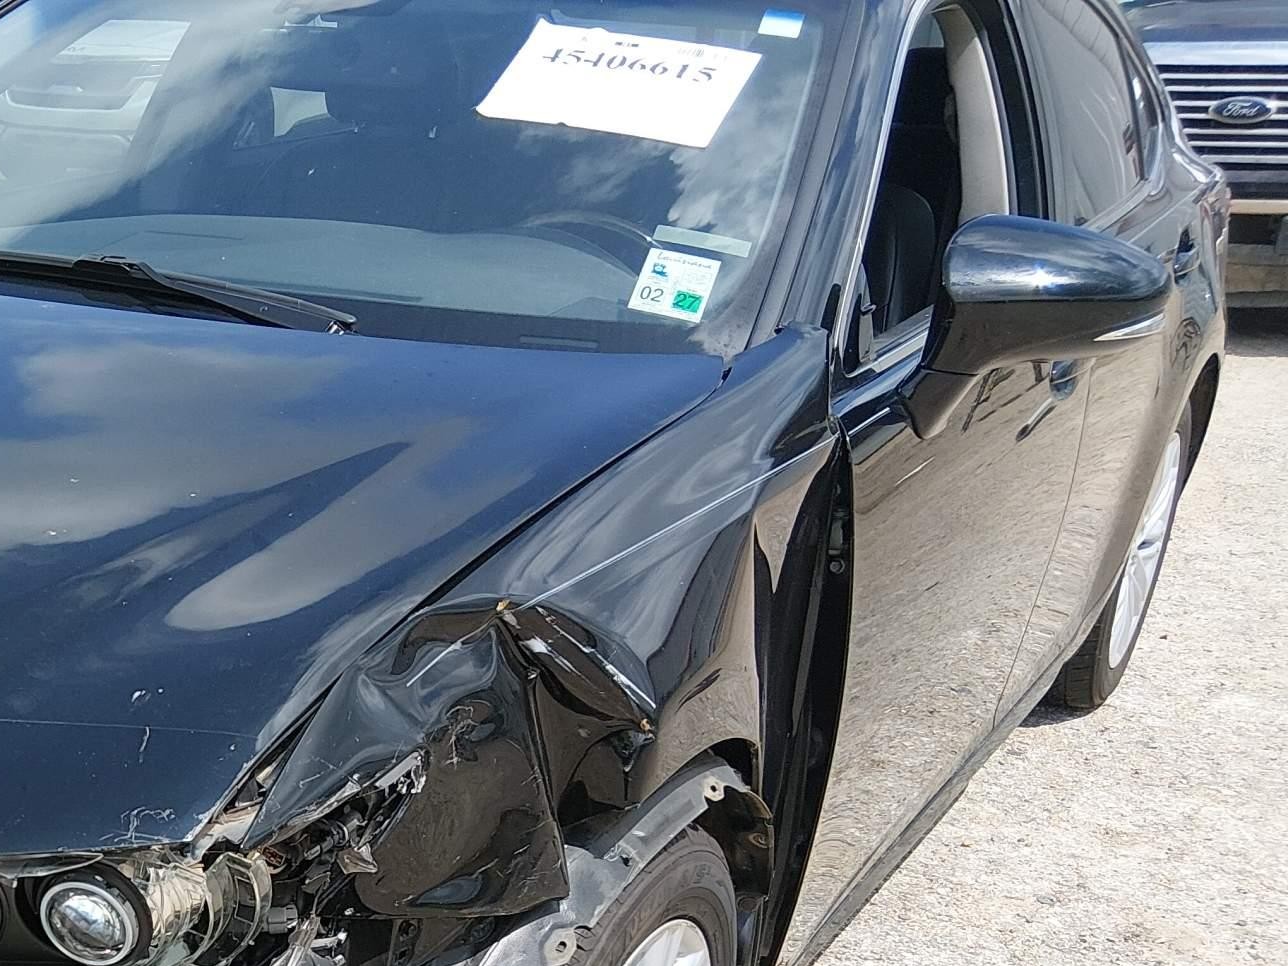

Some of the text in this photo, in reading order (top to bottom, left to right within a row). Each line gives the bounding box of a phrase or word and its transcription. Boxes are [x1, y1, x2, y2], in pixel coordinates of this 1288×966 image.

[542, 48, 718, 82] 45406615
[1222, 101, 1261, 117] Ford
[640, 286, 664, 303] 02
[673, 293, 703, 310] 27
